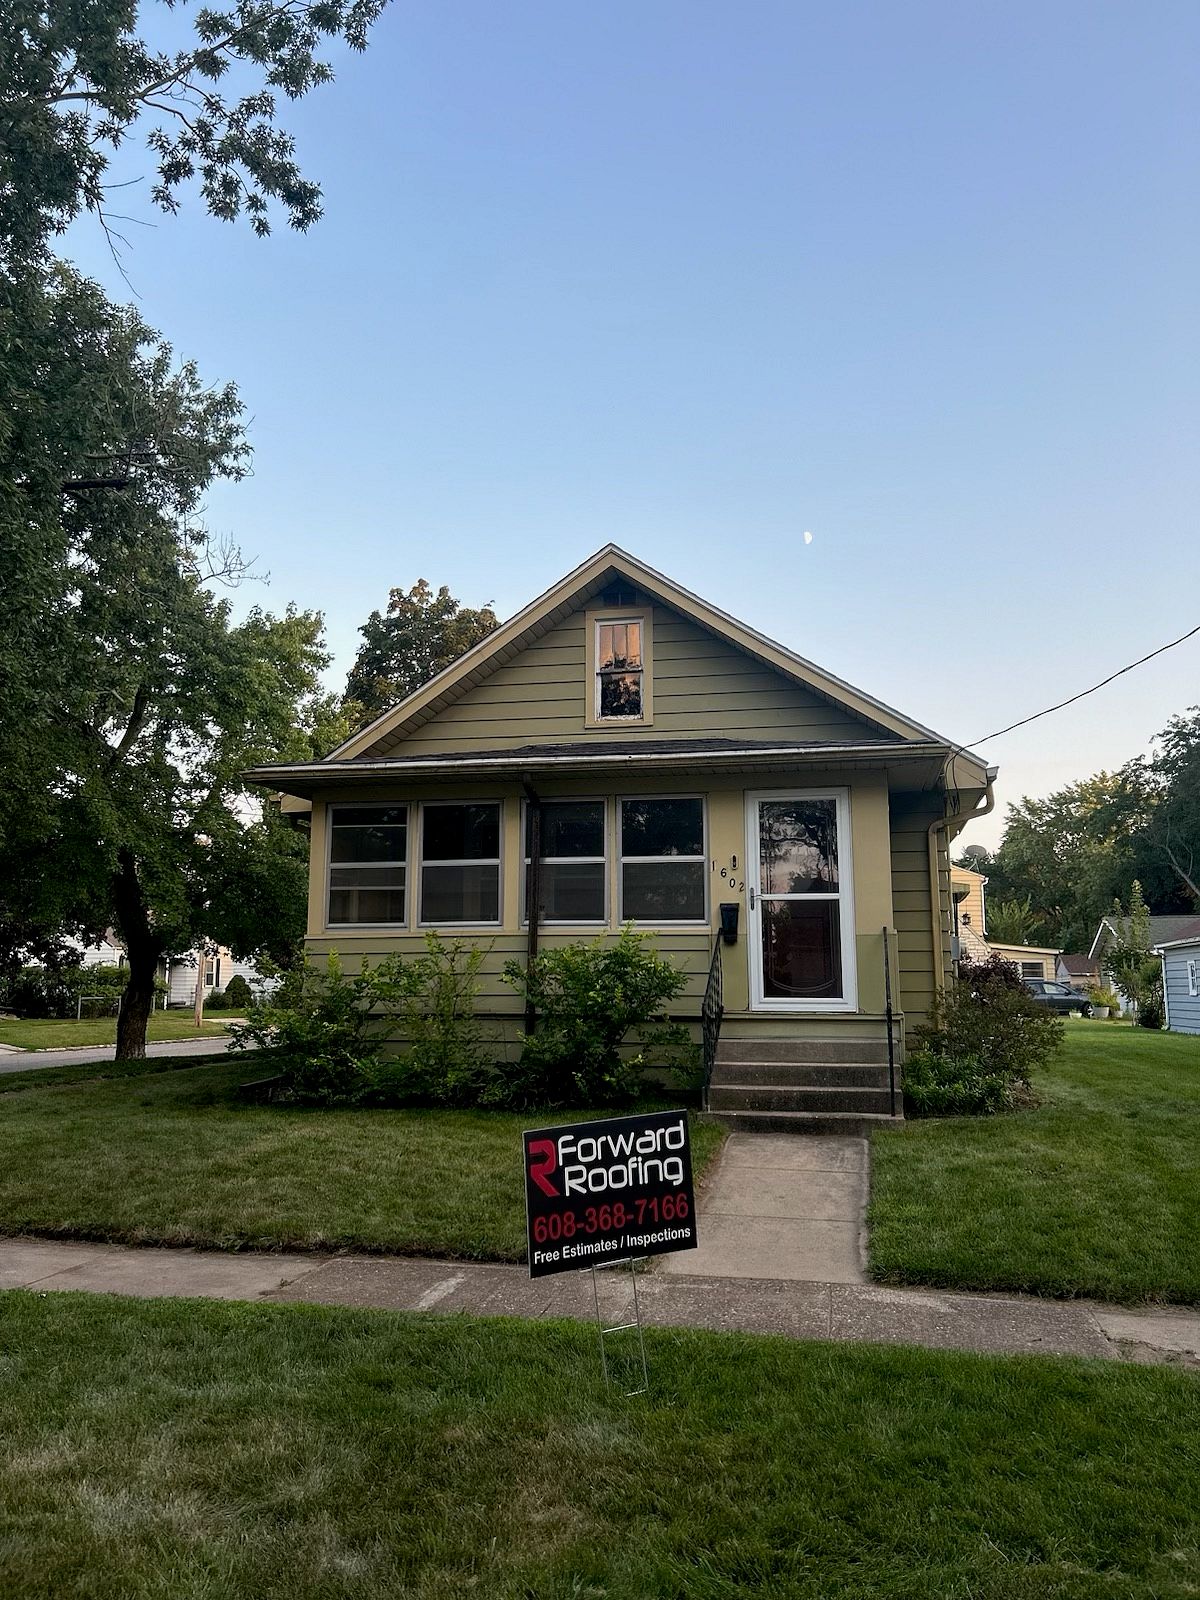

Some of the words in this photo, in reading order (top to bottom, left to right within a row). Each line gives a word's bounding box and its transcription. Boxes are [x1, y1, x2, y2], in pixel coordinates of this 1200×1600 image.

[712, 860, 745, 893] 1602
[557, 1119, 685, 1167] Forward
[564, 1156, 684, 1197] Roofing
[534, 1193, 689, 1243] 608-368-7166
[534, 1251, 560, 1265] Free
[562, 1238, 618, 1259] Estimates
[626, 1227, 691, 1247] Inspections
